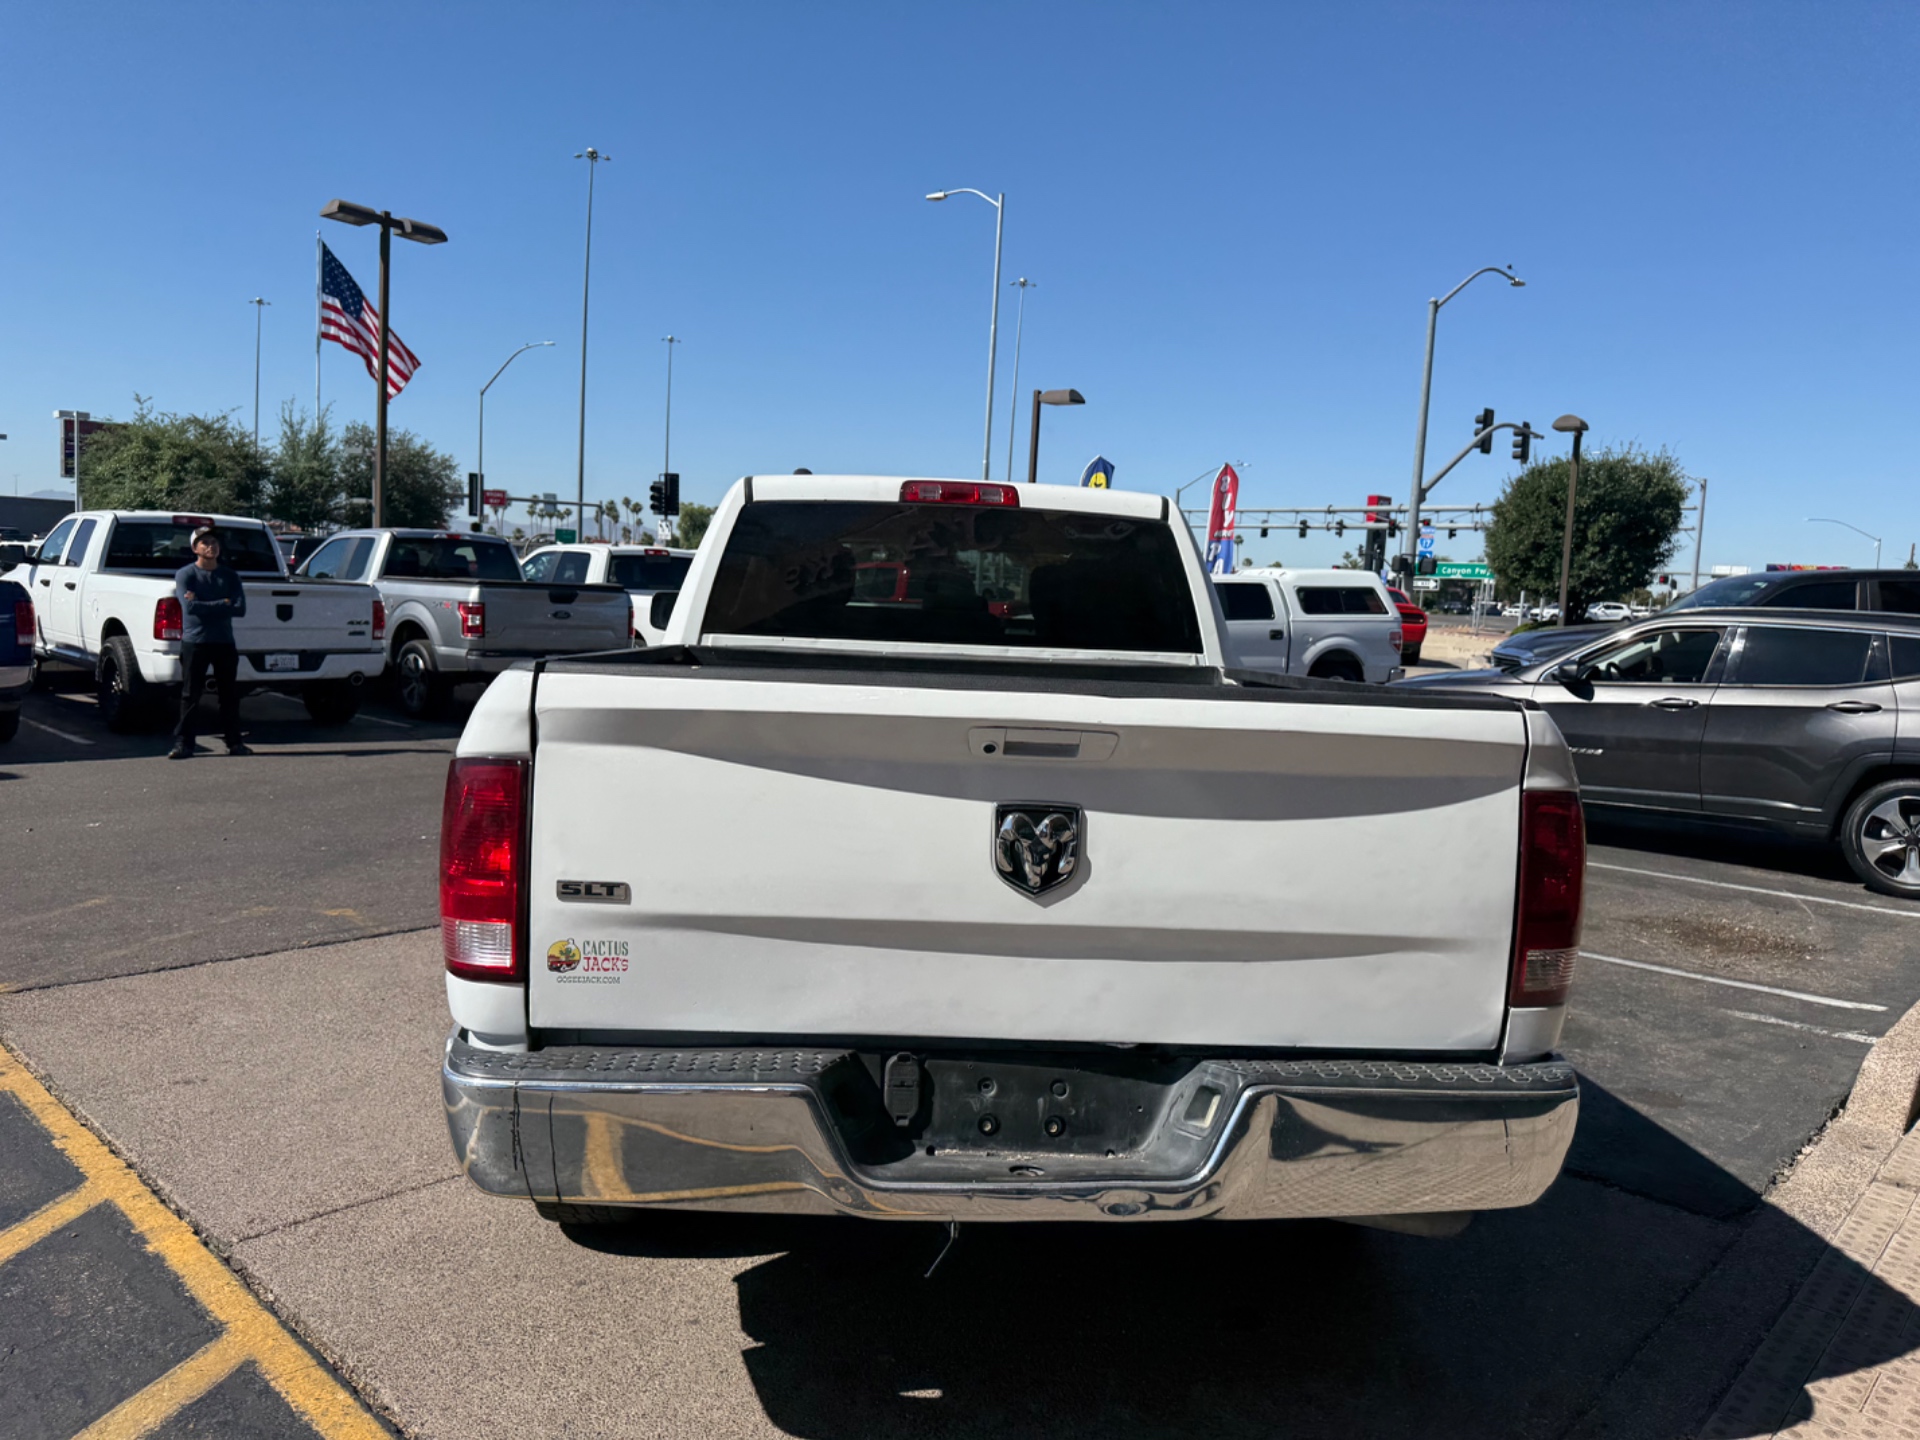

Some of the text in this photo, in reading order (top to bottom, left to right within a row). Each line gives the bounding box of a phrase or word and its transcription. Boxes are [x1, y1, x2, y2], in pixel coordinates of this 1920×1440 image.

[1441, 566, 1472, 576] Canyon
[561, 882, 621, 897] SLT
[582, 940, 629, 956] CACTUS
[582, 956, 629, 973] JACK'S
